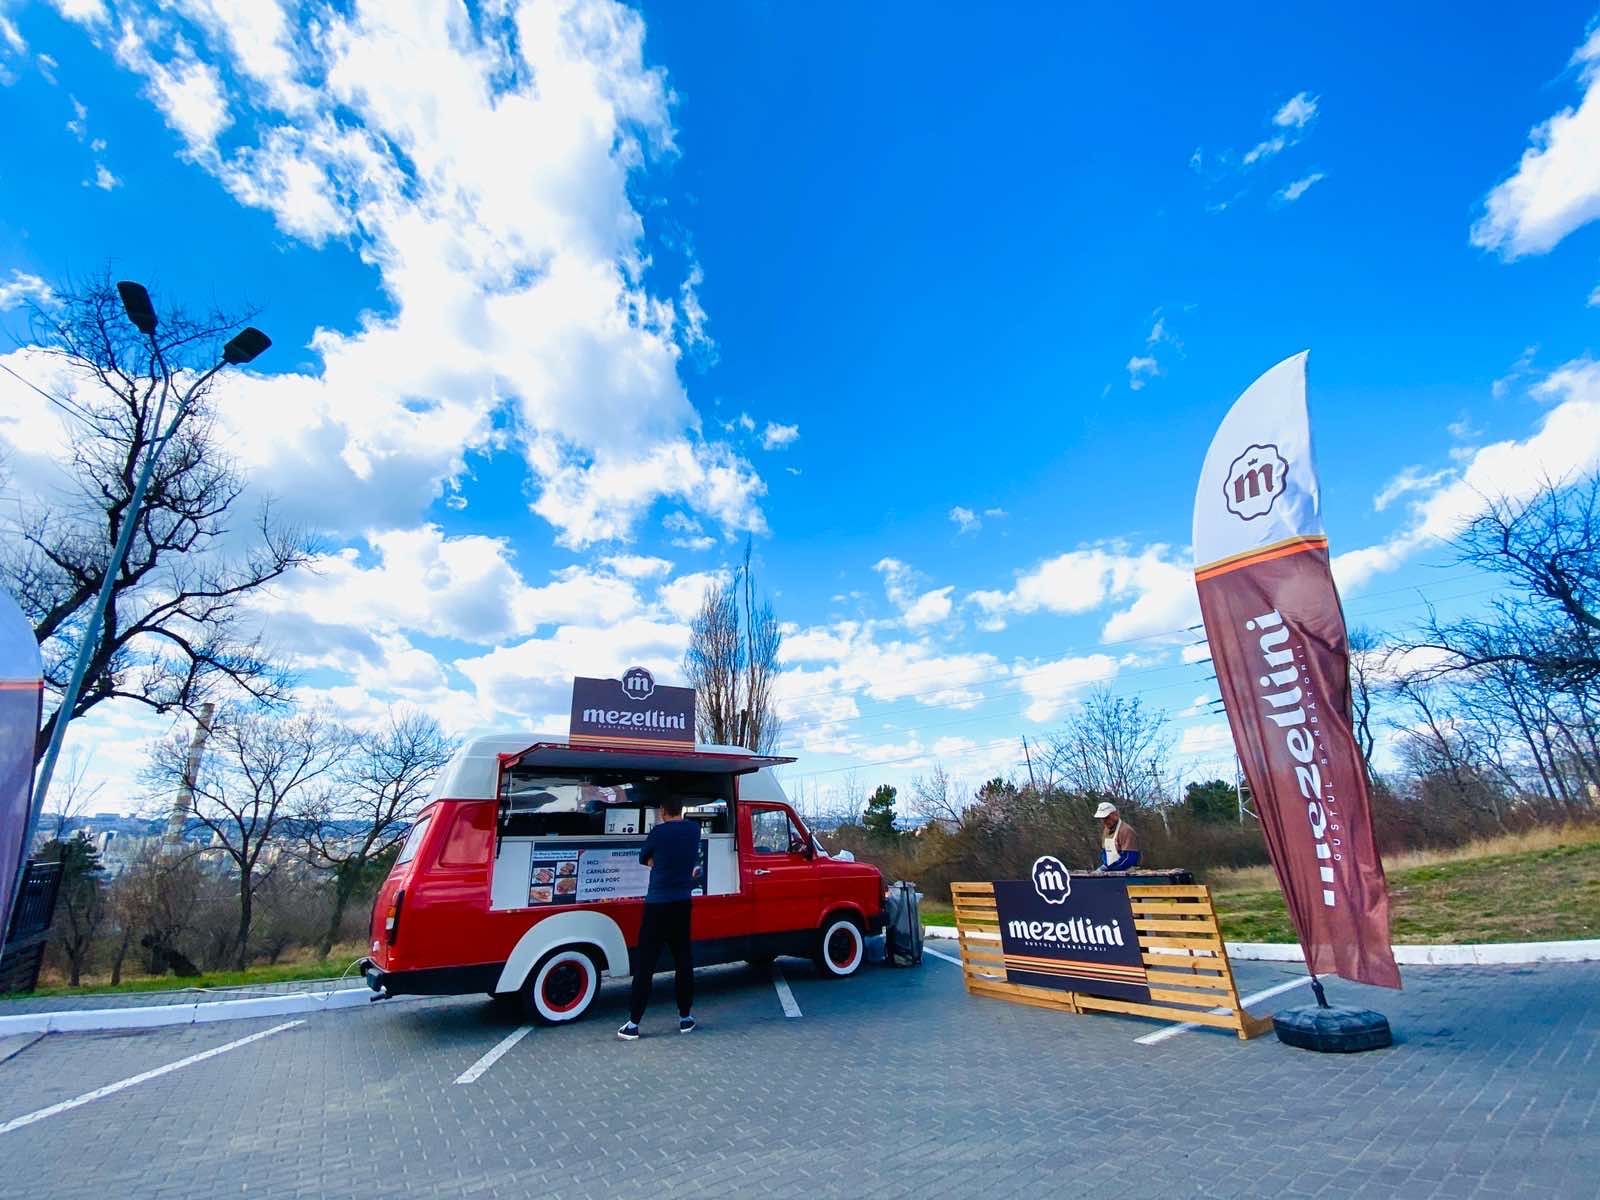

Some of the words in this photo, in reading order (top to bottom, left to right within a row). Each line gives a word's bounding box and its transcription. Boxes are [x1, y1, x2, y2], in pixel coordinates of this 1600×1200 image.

[583, 708, 686, 729] mezellini
[1324, 782, 1341, 862] GUSTUL
[1008, 916, 1124, 946] mezellini
